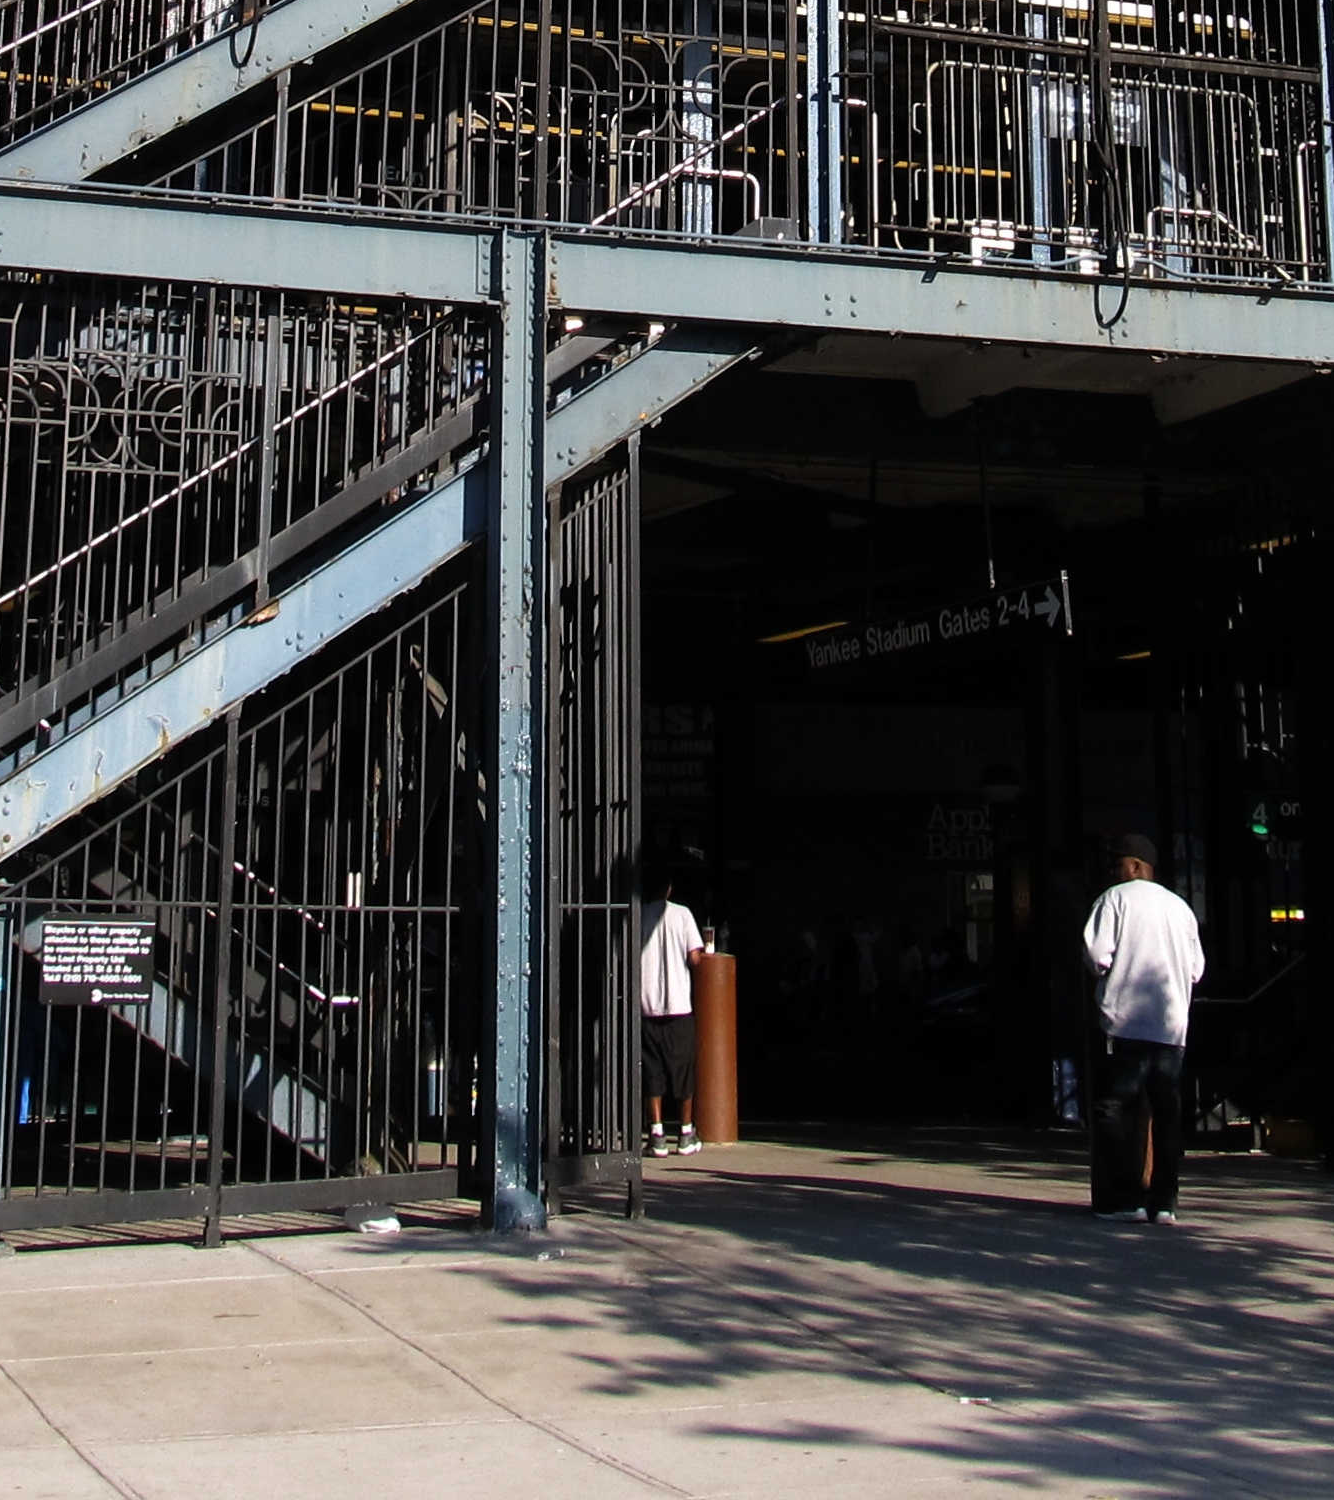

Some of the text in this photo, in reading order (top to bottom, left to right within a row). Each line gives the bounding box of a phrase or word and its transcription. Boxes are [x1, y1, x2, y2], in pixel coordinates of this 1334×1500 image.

[805, 589, 1031, 668] Yankee Stadium Gates 2-4
[1251, 801, 1269, 824] 4
[88, 926, 107, 935] other
[109, 926, 141, 937] property
[44, 936, 78, 945] attached
[79, 936, 88, 944] to
[89, 936, 111, 944] these
[55, 946, 88, 954] removed
[90, 946, 104, 954] and
[106, 946, 139, 955] delivered
[44, 955, 125, 964] the Lost Property Unit
[43, 964, 71, 973] located
[72, 965, 81, 973] at
